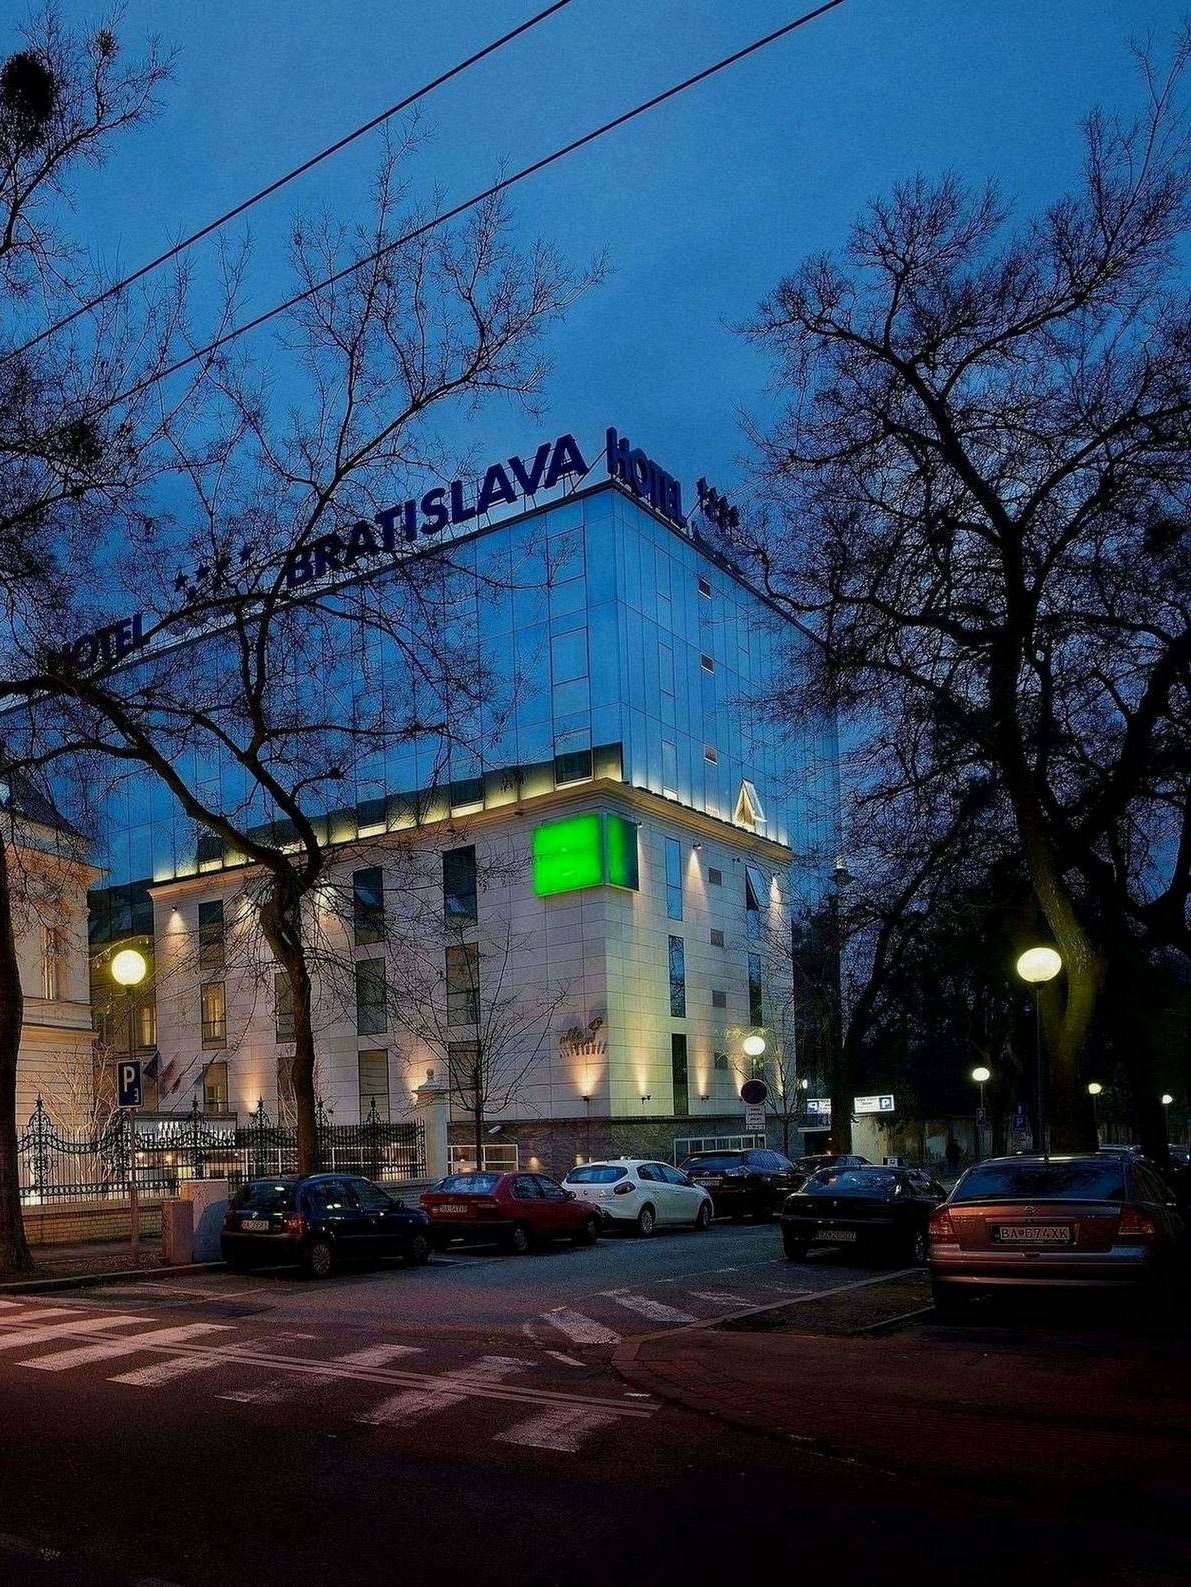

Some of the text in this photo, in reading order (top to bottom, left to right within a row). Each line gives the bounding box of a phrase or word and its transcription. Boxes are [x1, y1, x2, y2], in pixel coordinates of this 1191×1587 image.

[606, 426, 688, 528] HOTEL
[286, 433, 590, 590] BRATISLAVA
[123, 1066, 135, 1092] P
[881, 1099, 890, 1108] P
